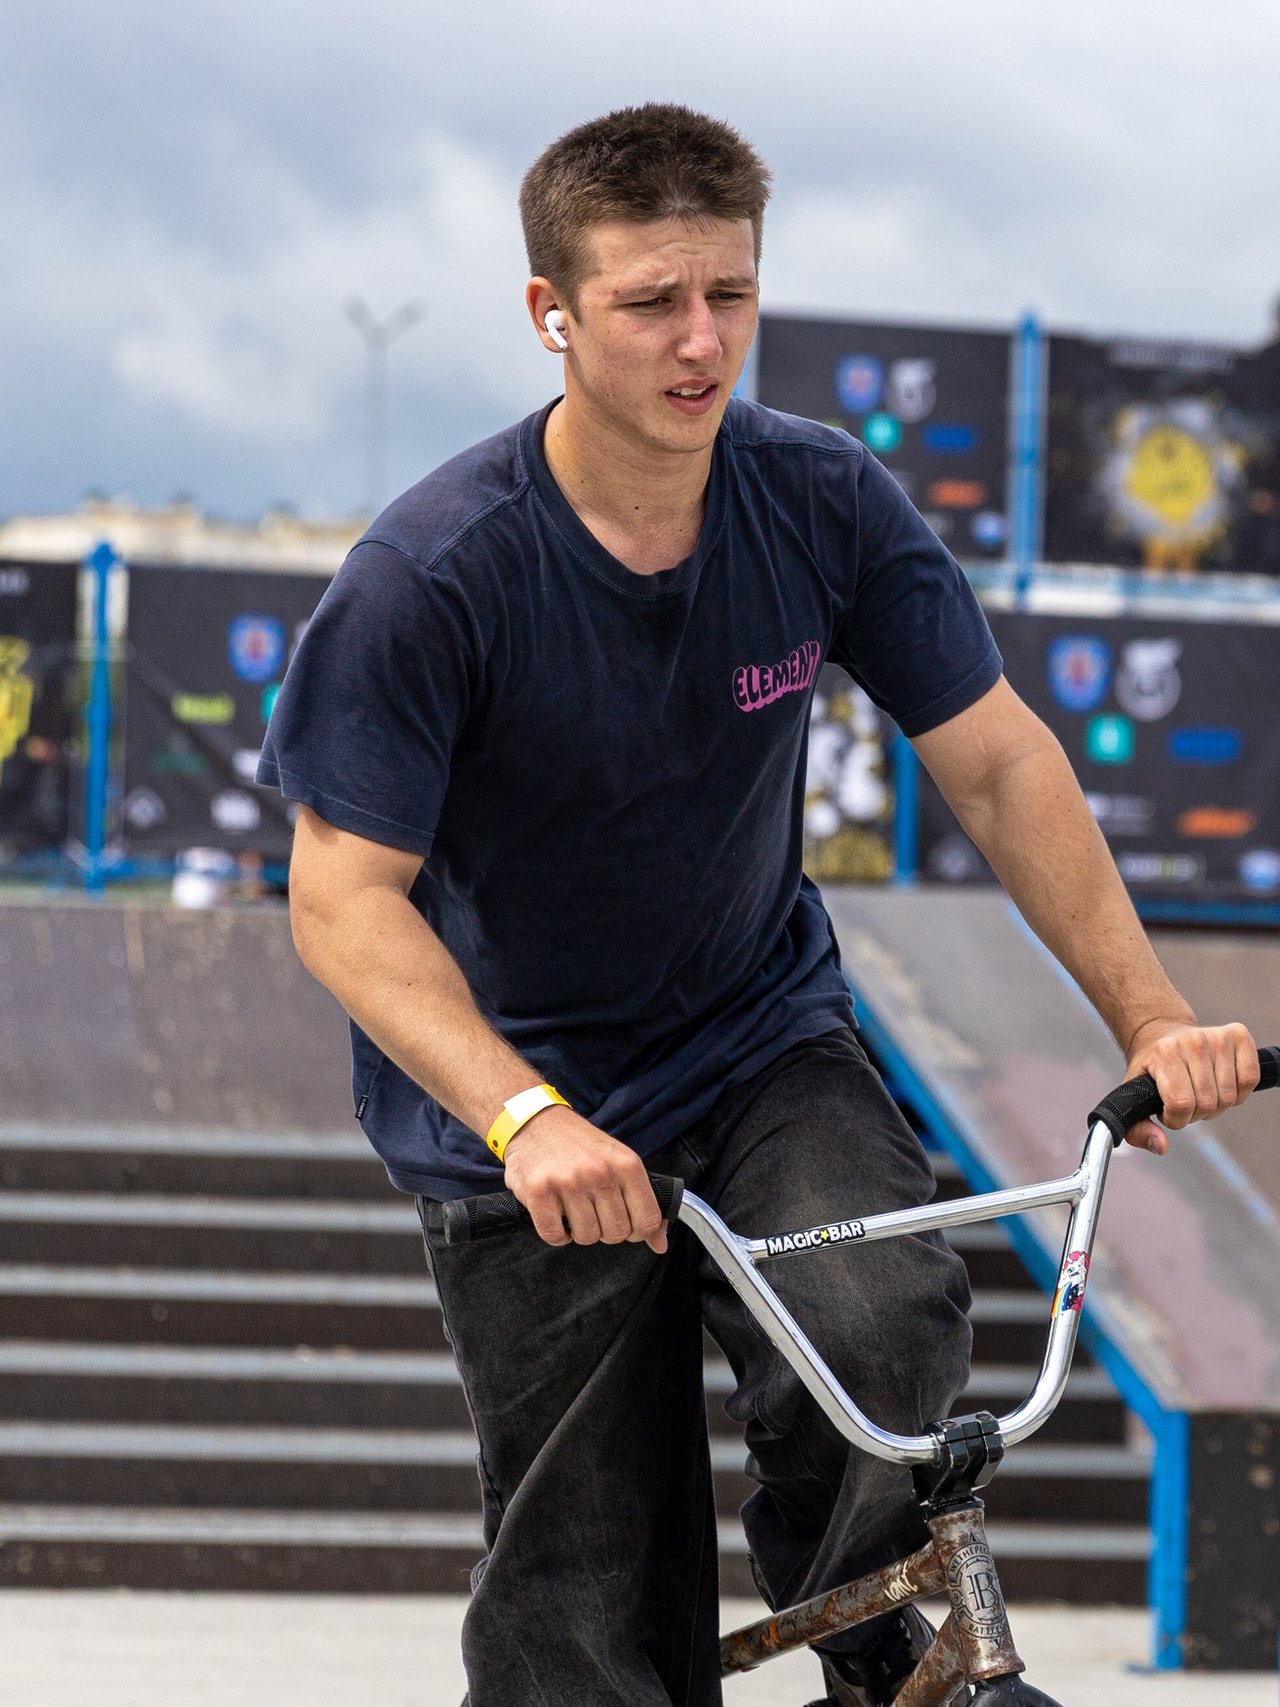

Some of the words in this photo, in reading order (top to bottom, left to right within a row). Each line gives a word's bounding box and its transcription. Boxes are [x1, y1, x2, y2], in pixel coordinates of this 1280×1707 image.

[732, 640, 820, 712] ELEMENT
[768, 1230, 823, 1254] MAGIC
[826, 1221, 863, 1241] BAR
[950, 1545, 990, 1572] WETHEPEO
